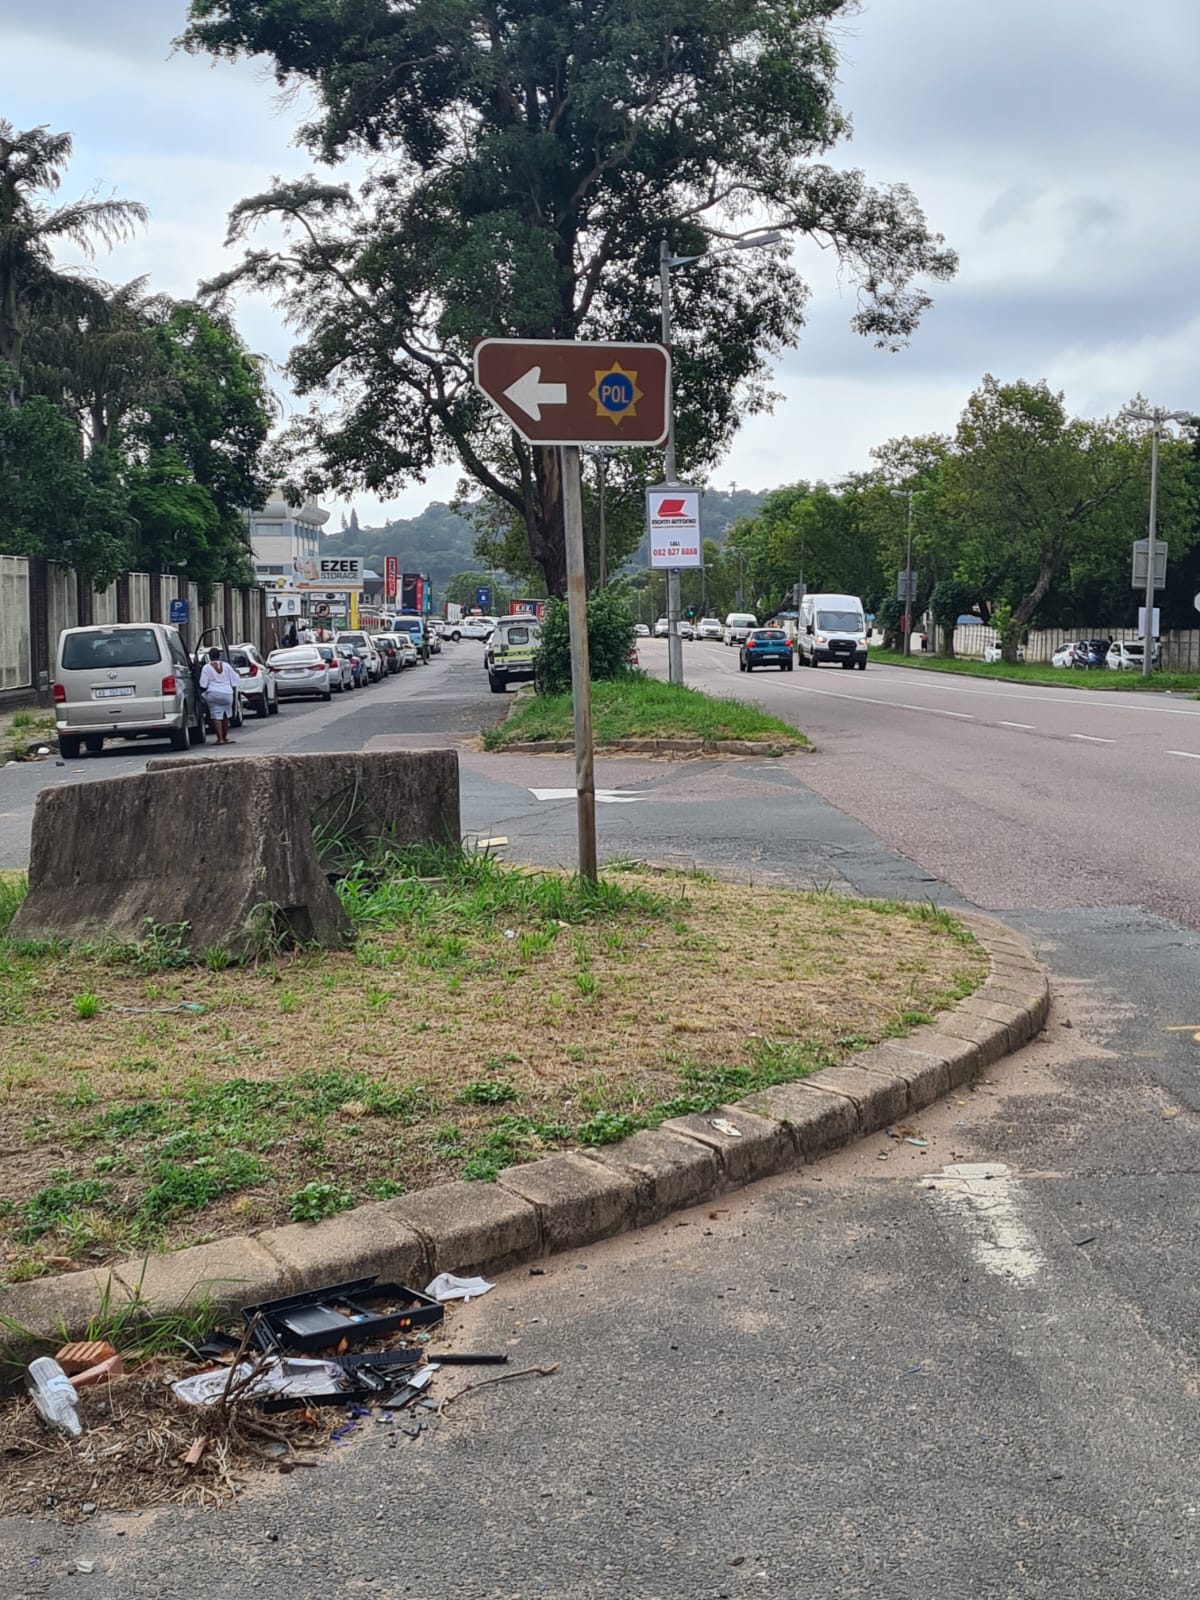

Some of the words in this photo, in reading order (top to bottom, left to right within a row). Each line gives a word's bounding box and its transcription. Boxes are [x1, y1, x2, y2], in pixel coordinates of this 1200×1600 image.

[602, 385, 630, 403] POL
[321, 560, 358, 572] EZEE
[175, 601, 183, 610] P
